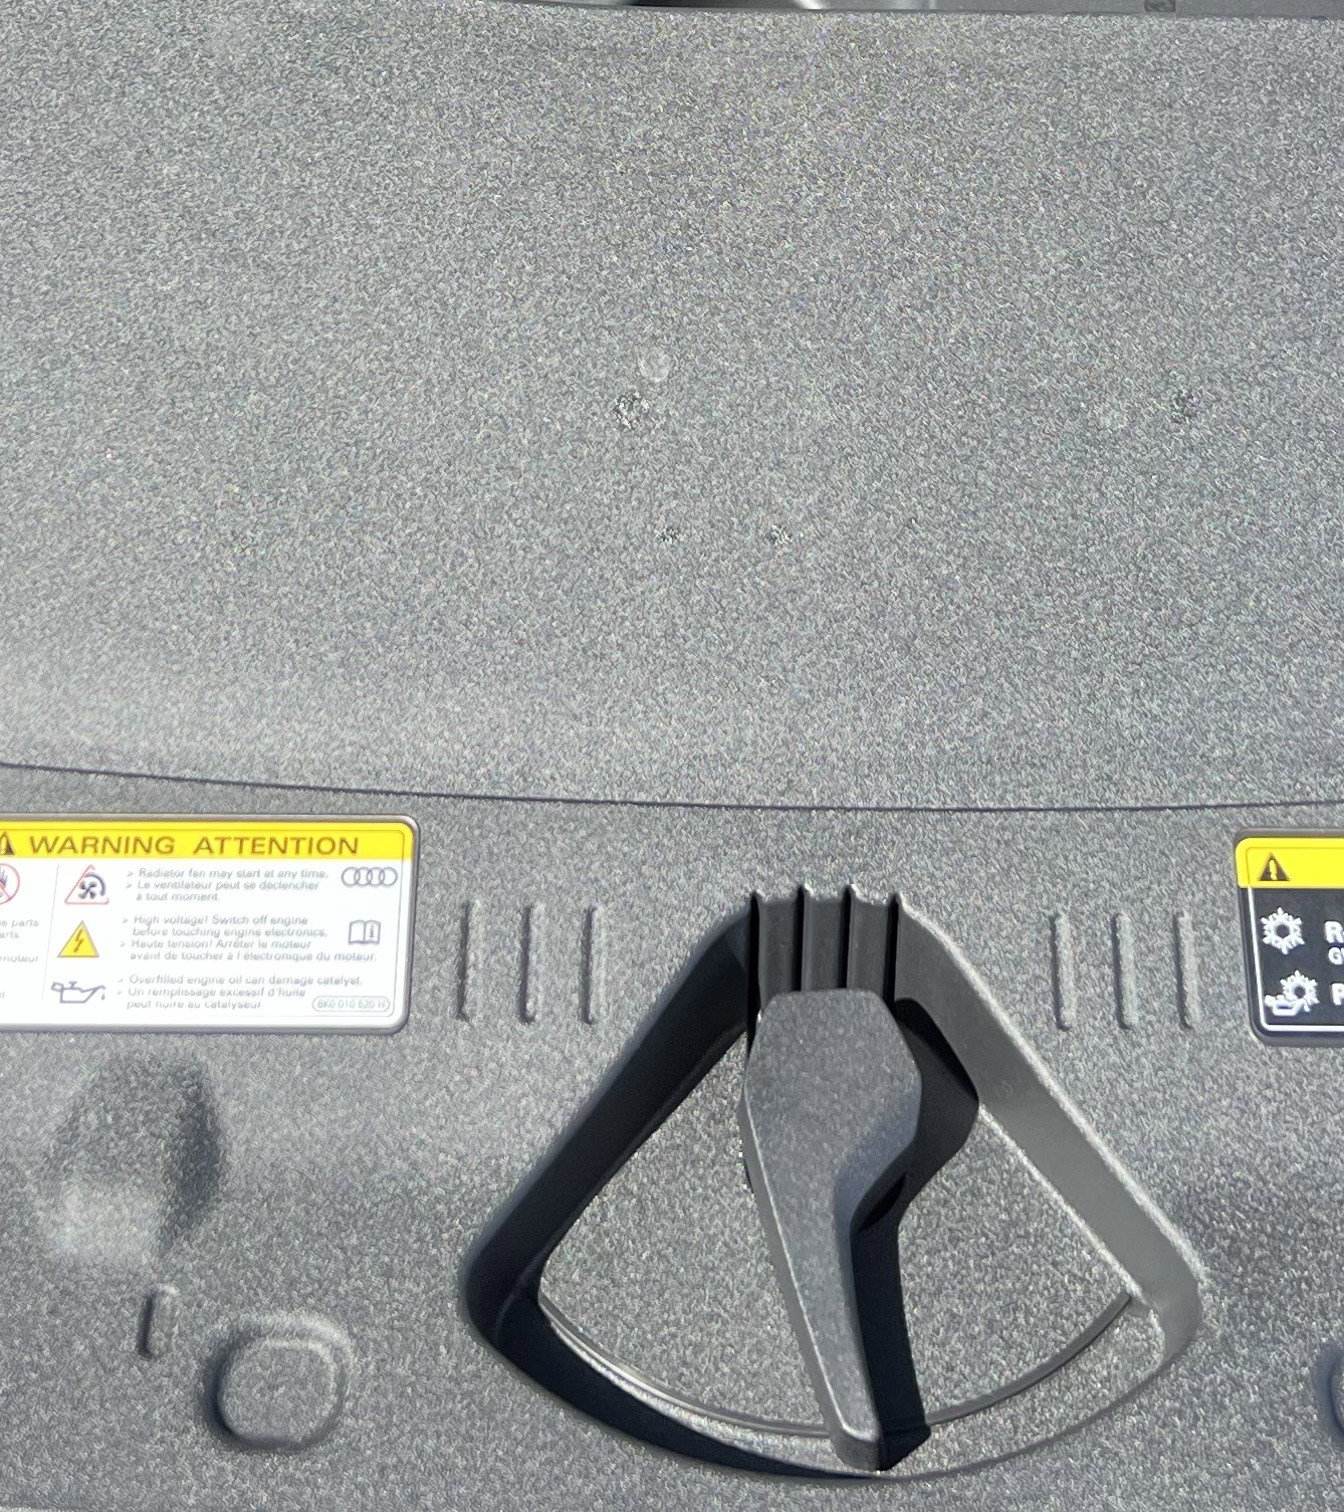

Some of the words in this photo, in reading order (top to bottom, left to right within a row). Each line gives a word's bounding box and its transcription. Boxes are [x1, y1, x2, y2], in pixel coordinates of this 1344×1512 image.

[29, 836, 175, 855] WARNING
[193, 836, 359, 855] ATTENTION
[139, 869, 184, 878] Radiator
[189, 869, 206, 878] fan
[209, 870, 232, 880] may
[237, 870, 261, 878] start
[264, 870, 275, 878] at
[278, 870, 296, 880] any
[138, 881, 151, 889] Le
[216, 882, 240, 892] peut
[12, 919, 39, 928] parts
[134, 916, 159, 928] High
[213, 915, 249, 925] Switch
[253, 915, 267, 925] off
[271, 917, 308, 926] engine
[132, 927, 168, 936] before
[172, 928, 220, 938] touching
[224, 928, 261, 937] engine
[131, 940, 164, 948] Haute
[258, 940, 267, 948] le
[271, 940, 311, 948] moteur
[0, 954, 39, 963] moteur
[164, 952, 178, 960] de
[181, 952, 223, 961] toucher
[316, 952, 330, 961] du
[129, 975, 184, 984] Overfilled
[187, 976, 225, 986] engine
[229, 976, 242, 984] oil
[269, 976, 314, 986] damage
[128, 988, 145, 996] Un
[220, 987, 265, 996] excessif
[126, 999, 152, 1010] peut
[188, 1001, 201, 1009] au
